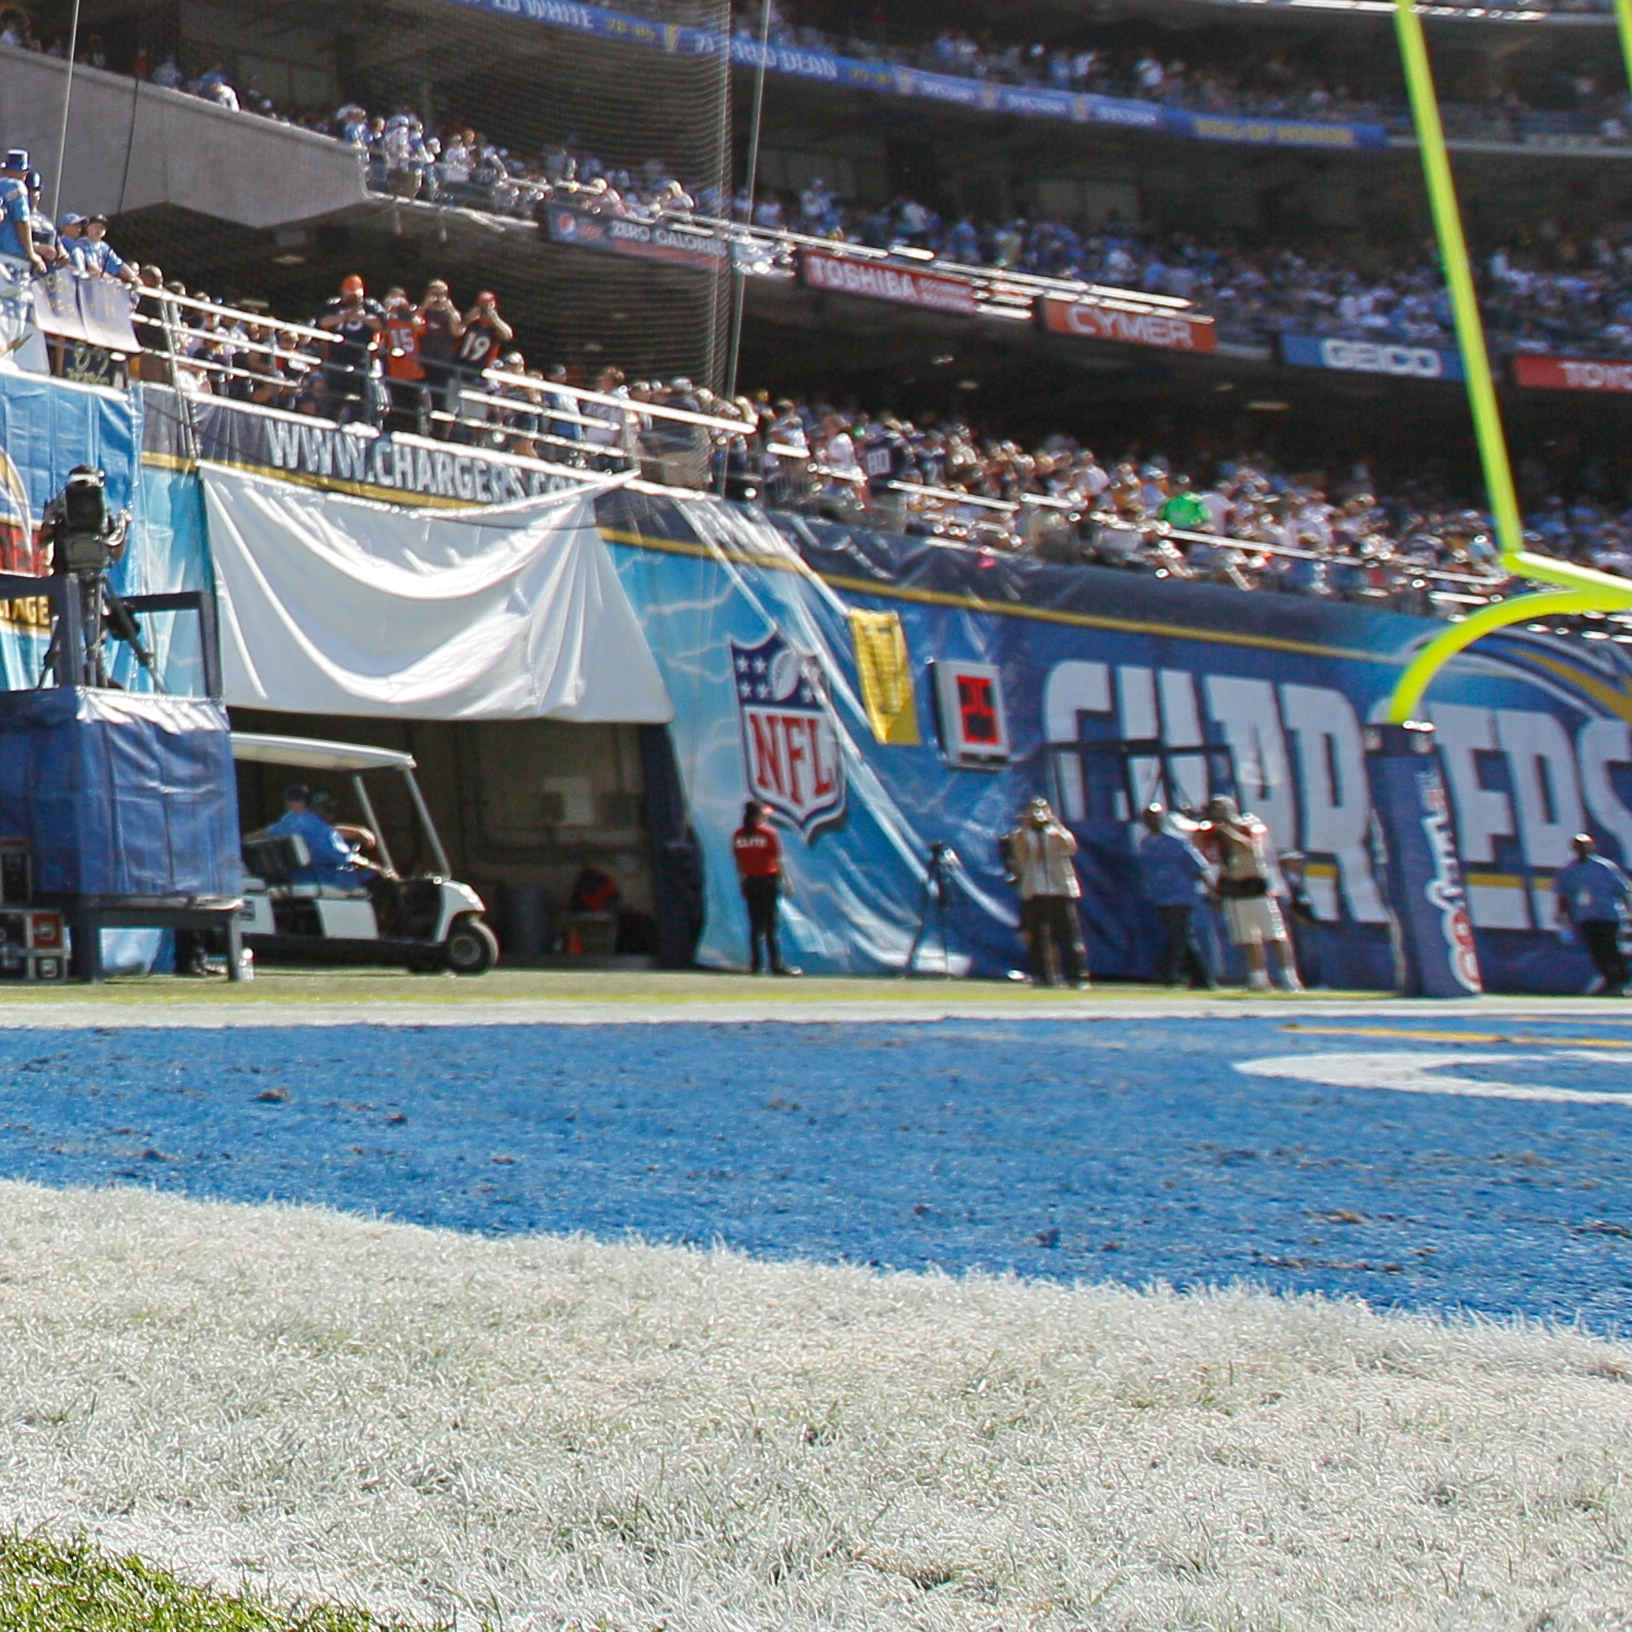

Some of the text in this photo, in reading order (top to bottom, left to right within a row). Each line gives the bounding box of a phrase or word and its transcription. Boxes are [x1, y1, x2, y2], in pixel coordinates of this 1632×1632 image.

[808, 254, 916, 300] TOSHIBA
[460, 334, 491, 361] 19
[1065, 303, 1195, 349] CYMER
[1324, 338, 1442, 378] GEICO
[748, 713, 834, 806] NFL
